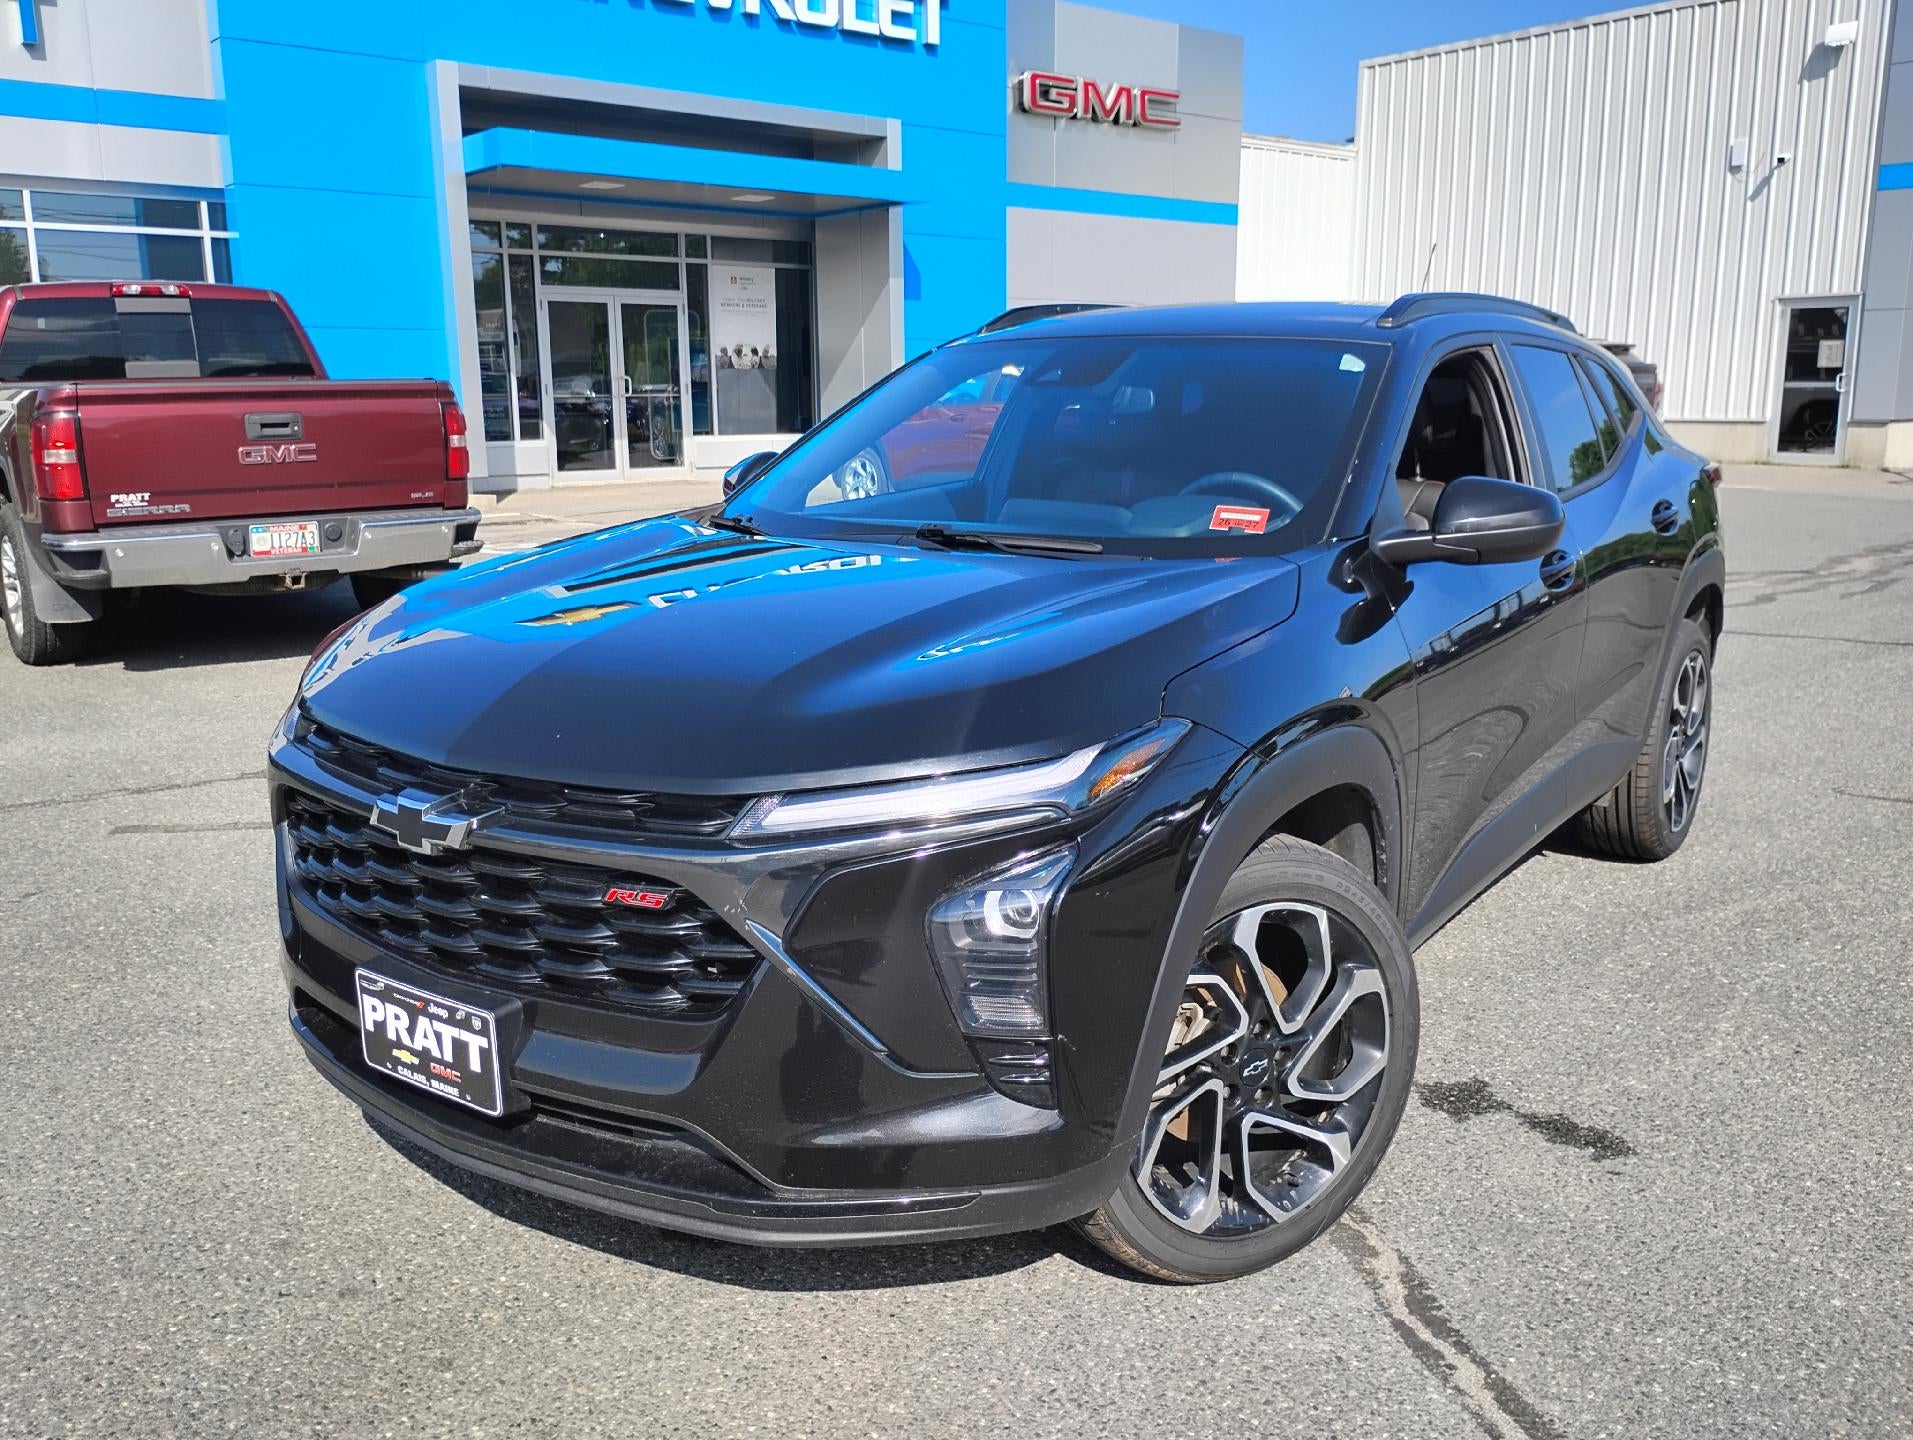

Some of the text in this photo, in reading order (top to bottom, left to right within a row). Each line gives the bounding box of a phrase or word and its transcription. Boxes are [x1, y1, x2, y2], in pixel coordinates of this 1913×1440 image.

[1024, 71, 1182, 131] GMC
[238, 443, 317, 464] GMC
[110, 492, 151, 503] PRATT
[269, 524, 299, 533] MAINE
[606, 888, 668, 908] RS
[428, 1002, 448, 1019] Jeep
[362, 994, 489, 1073] PRATT
[430, 1062, 461, 1083] GMC
[430, 1079, 460, 1097] MAINE
